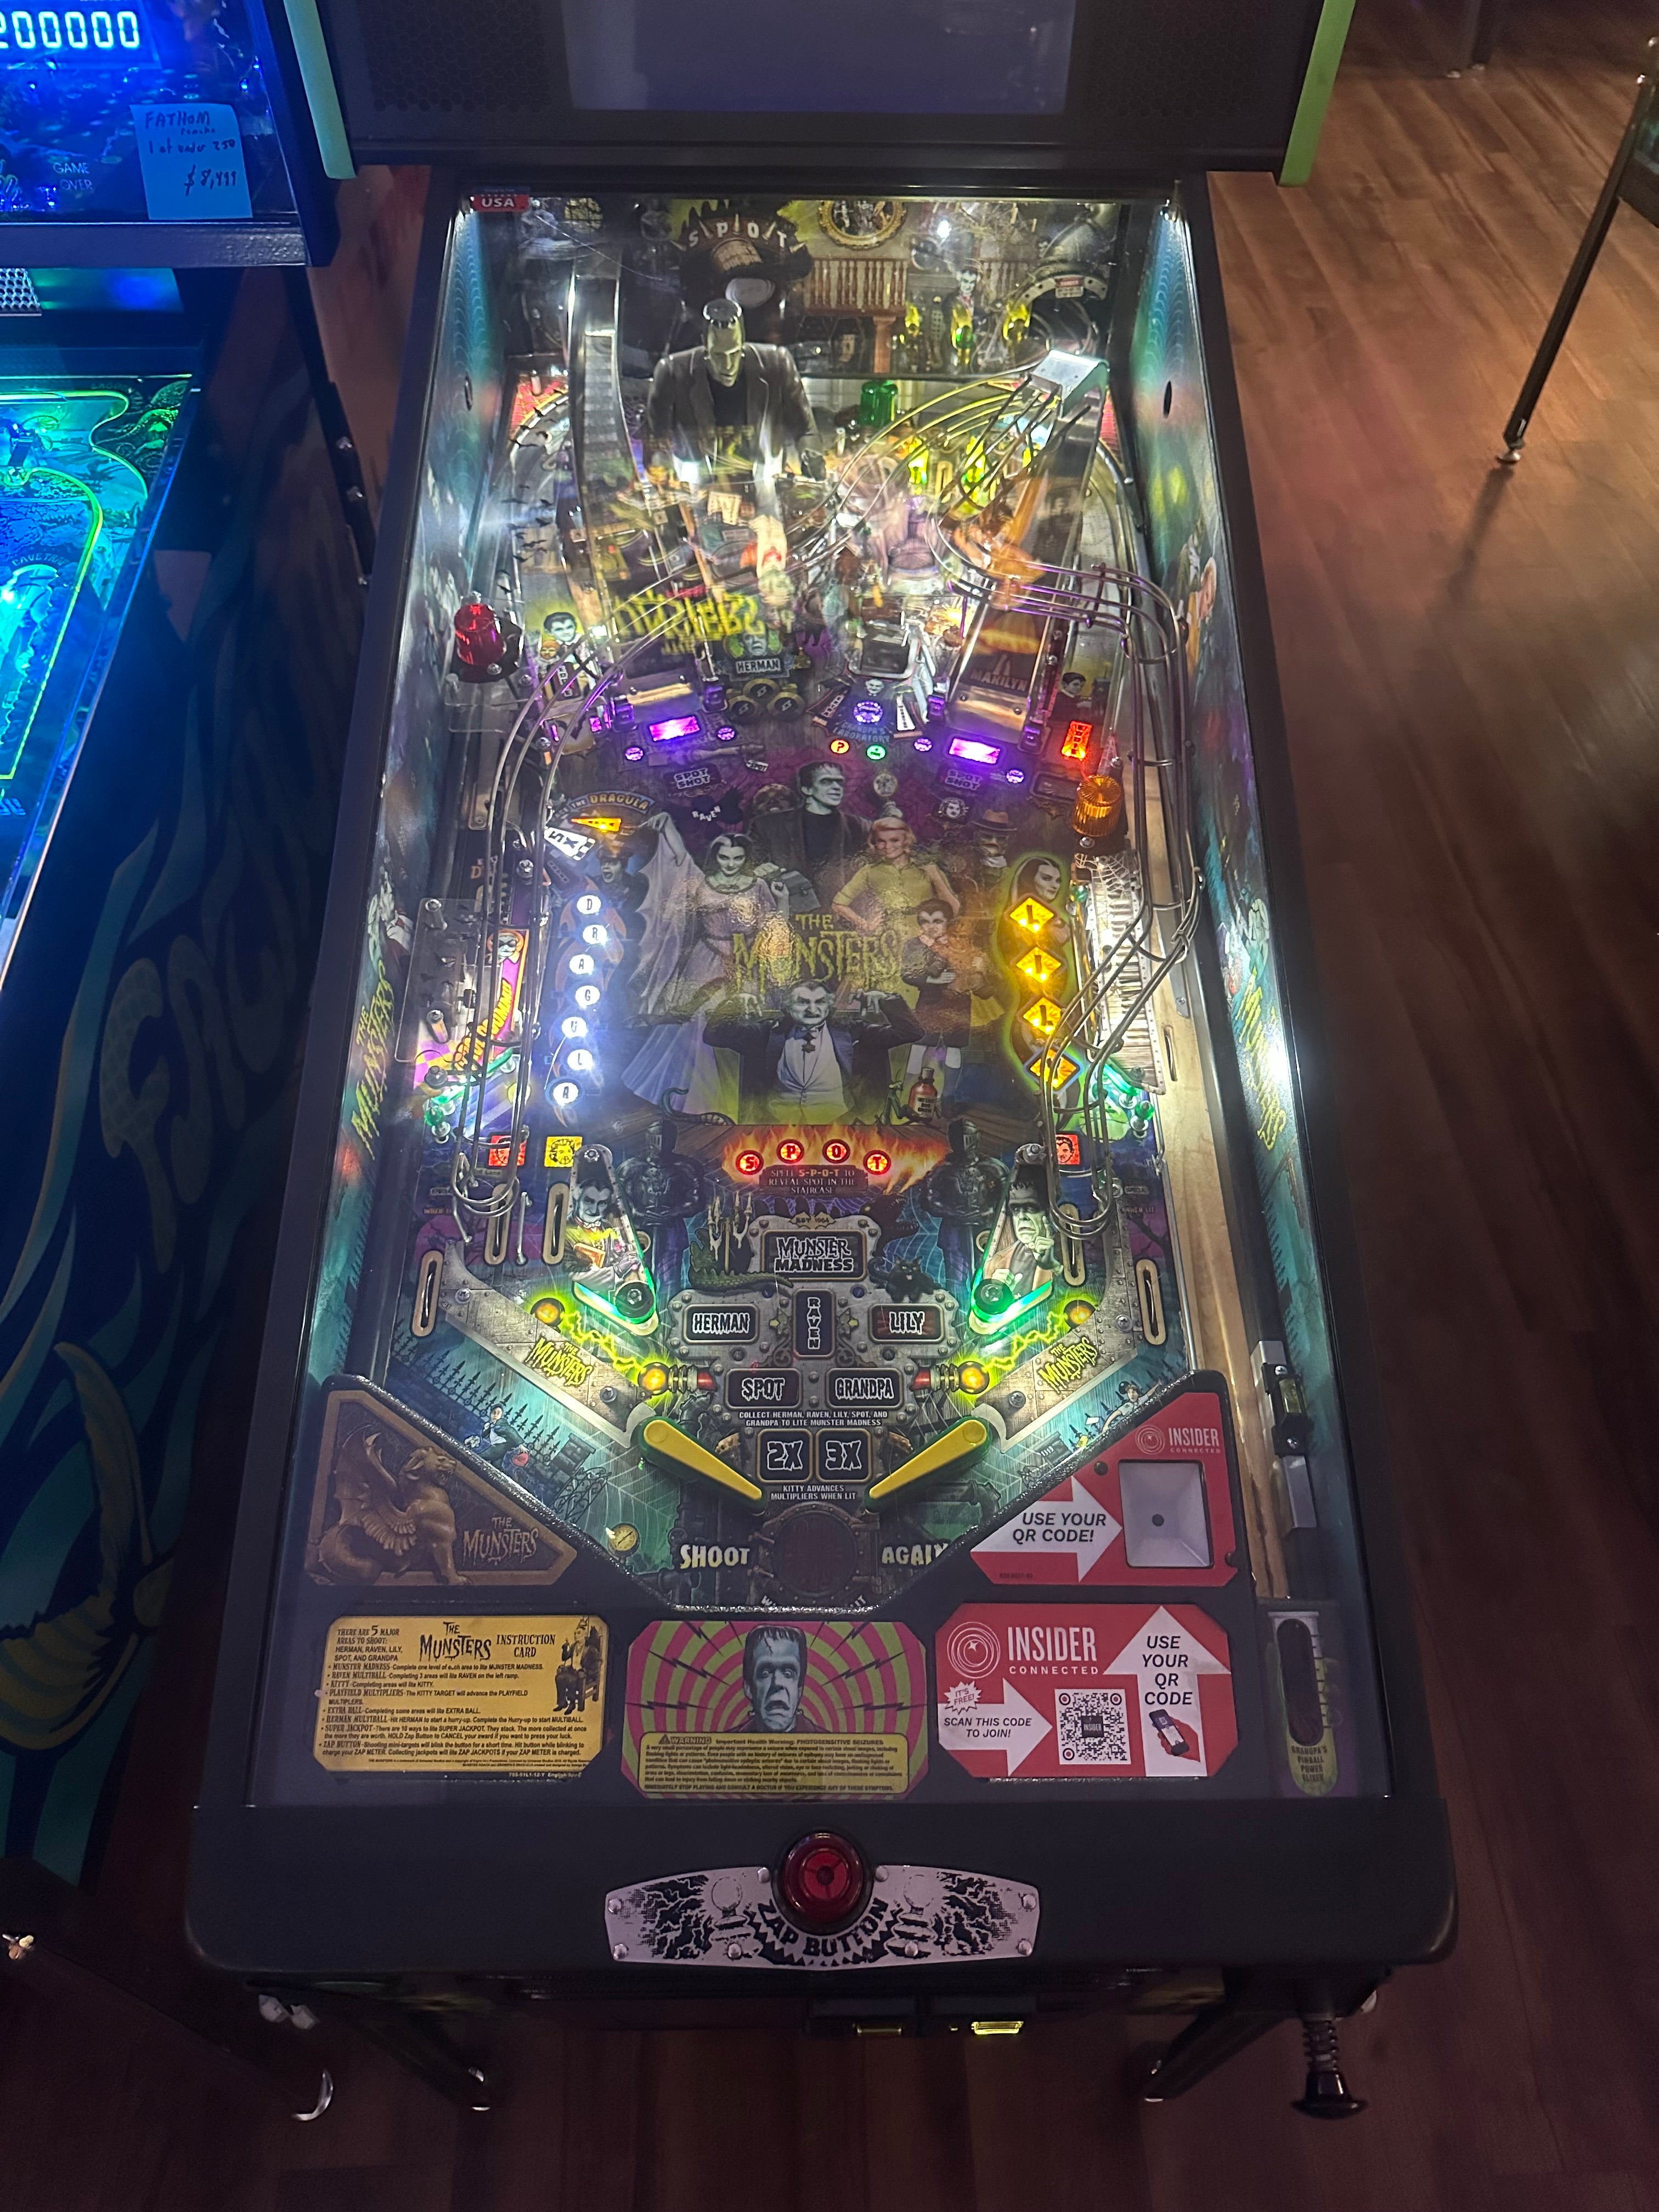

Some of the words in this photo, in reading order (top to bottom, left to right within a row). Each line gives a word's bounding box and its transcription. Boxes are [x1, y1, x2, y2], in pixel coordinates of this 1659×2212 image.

[145, 110, 210, 129] FATHOM
[54, 162, 90, 173] GAME
[60, 179, 93, 190] OVER
[481, 198, 515, 207] USA
[12, 553, 43, 566] CAVE
[736, 658, 781, 673] HERMAN
[970, 668, 1029, 691] MARILYN
[674, 768, 708, 782] SPOT
[676, 775, 710, 789] SHOT
[589, 793, 650, 811] DRAGULA
[692, 805, 721, 822] RAVEN
[795, 914, 834, 930] THE
[798, 1169, 839, 1177] S-P-O-T
[777, 1236, 852, 1261] MUNSTER
[775, 1258, 854, 1273] MADNESS
[691, 1313, 751, 1335] HERMAN
[807, 1296, 821, 1350] RAVEN
[889, 1311, 925, 1335] LILY
[563, 1341, 579, 1357] THE
[1050, 1343, 1066, 1357] THE
[525, 1338, 593, 1386] MUNSTERS
[1037, 1336, 1097, 1393] MUNSTERS
[741, 1377, 785, 1401] SPOT
[834, 1377, 895, 1400] GRANDPA
[772, 1411, 805, 1419] HERMAN,
[806, 1411, 831, 1419] RAVEN,
[833, 1411, 849, 1419] LILY,
[851, 1411, 871, 1419] SPOT,
[1169, 1427, 1220, 1448] INSIDER
[766, 1440, 804, 1471] 2X
[825, 1440, 862, 1471] 3X
[492, 1516, 512, 1528] THE
[1022, 1513, 1056, 1526] USE
[1060, 1513, 1107, 1527] YOUR
[1012, 1529, 1036, 1545] QR
[1042, 1529, 1094, 1543] CODE!
[462, 1527, 539, 1566] MUNSTERS
[680, 1544, 751, 1570] SHOOT
[371, 1625, 379, 1637] 5
[443, 1621, 460, 1635] THE
[496, 1634, 556, 1646] INSTRUCTION
[1007, 1627, 1097, 1662] INSIDER
[1147, 1635, 1181, 1649] USE
[419, 1634, 492, 1662] MUNSTERS
[514, 1646, 537, 1658] CARD
[1142, 1654, 1189, 1668] YOUR
[1009, 1666, 1099, 1675] CONNECTED
[1154, 1673, 1180, 1688] QR
[953, 1694, 974, 1706] FREE!
[955, 1688, 969, 1698] IT'S
[1144, 1691, 1193, 1706] CODE
[944, 1717, 972, 1726] SCAN
[975, 1717, 1000, 1726] THIS
[1003, 1717, 1032, 1726] CODE
[670, 1736, 712, 1745] WARNING
[967, 1729, 980, 1738] TO
[983, 1729, 1011, 1739] JOIN!
[1297, 1755, 1325, 1763] PINBALL
[1300, 1764, 1323, 1773] POWER
[758, 1898, 799, 1945] ZAP
[802, 1897, 889, 1957] BUTTON
